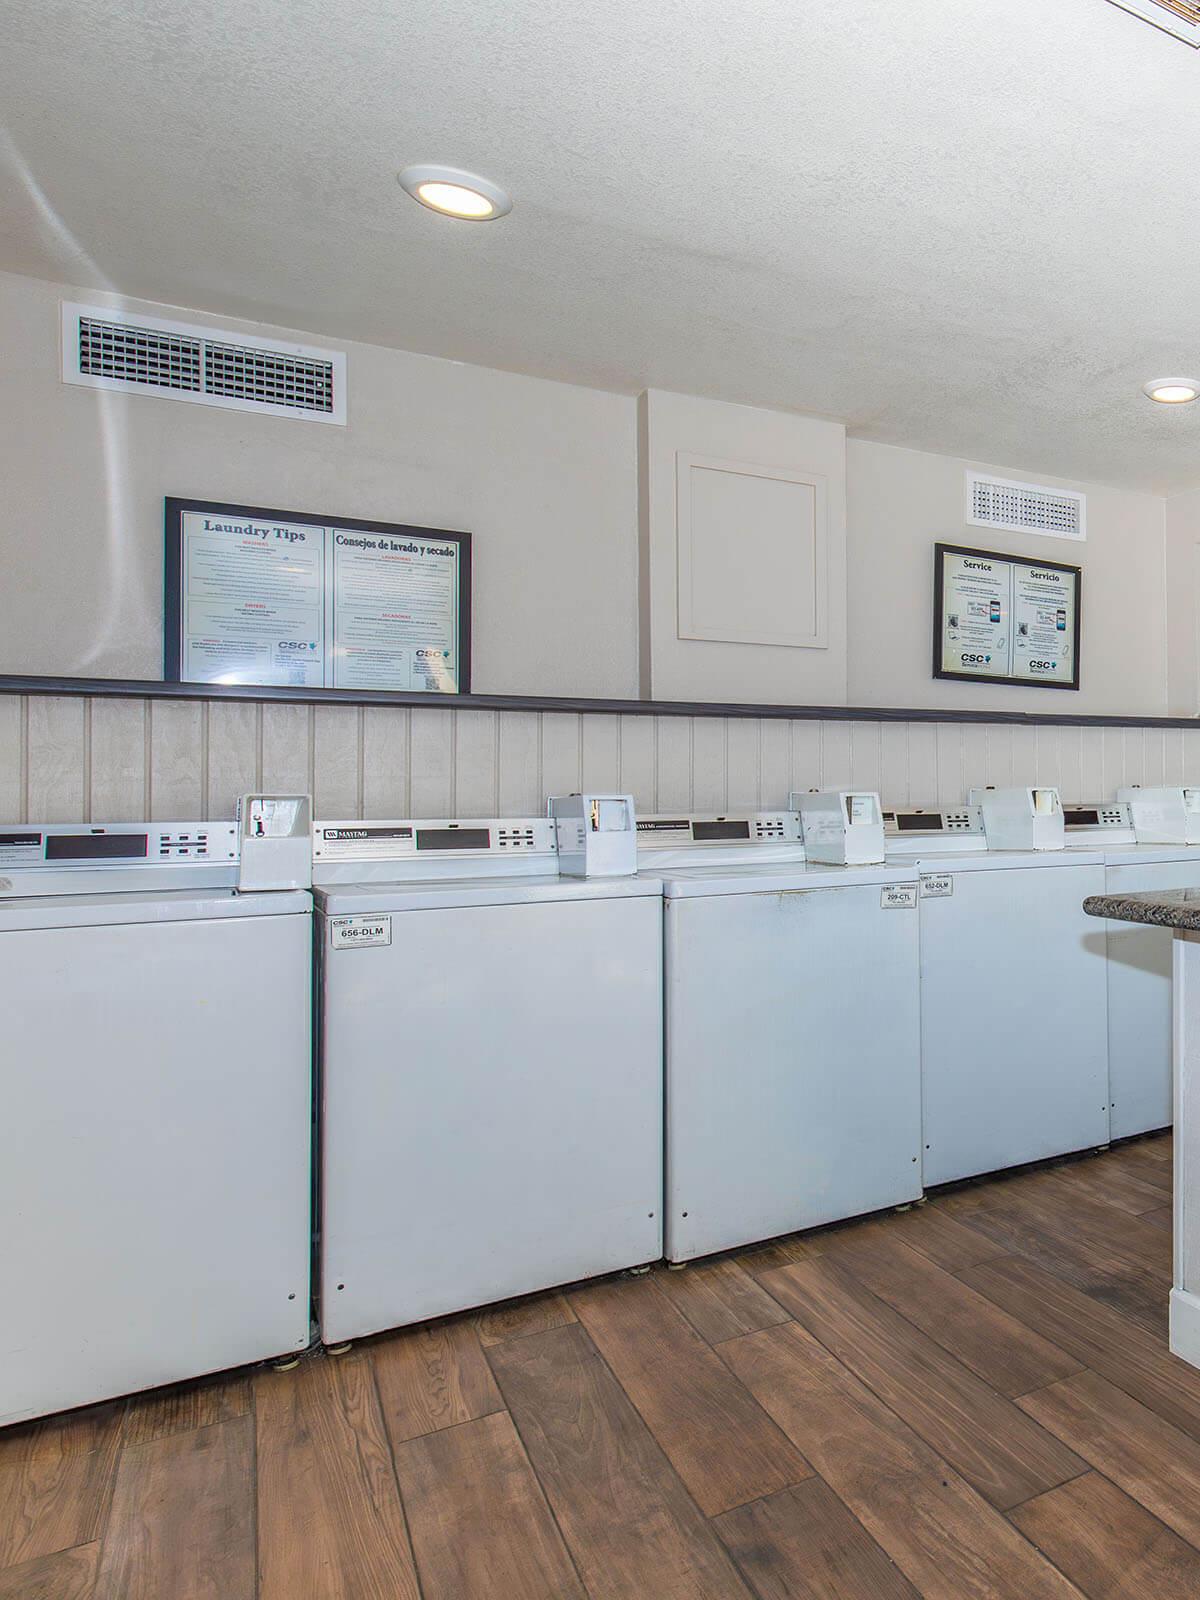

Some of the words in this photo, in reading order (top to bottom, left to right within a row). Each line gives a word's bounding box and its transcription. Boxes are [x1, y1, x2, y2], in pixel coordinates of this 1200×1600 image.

[204, 520, 270, 539] Laundry
[273, 527, 306, 543] Tips
[336, 534, 377, 551] Consejos
[378, 540, 389, 549] de
[391, 540, 418, 553] lavado
[420, 547, 427, 556] y
[427, 546, 455, 557] secado
[963, 559, 992, 572] Service
[1030, 570, 1060, 582] Servicio
[278, 641, 308, 650] CSC
[415, 648, 442, 658] CSC
[961, 653, 984, 663] CSC
[1029, 660, 1050, 669] CSC
[338, 831, 368, 839] MAYTAG
[341, 927, 384, 938] 656-DLM
